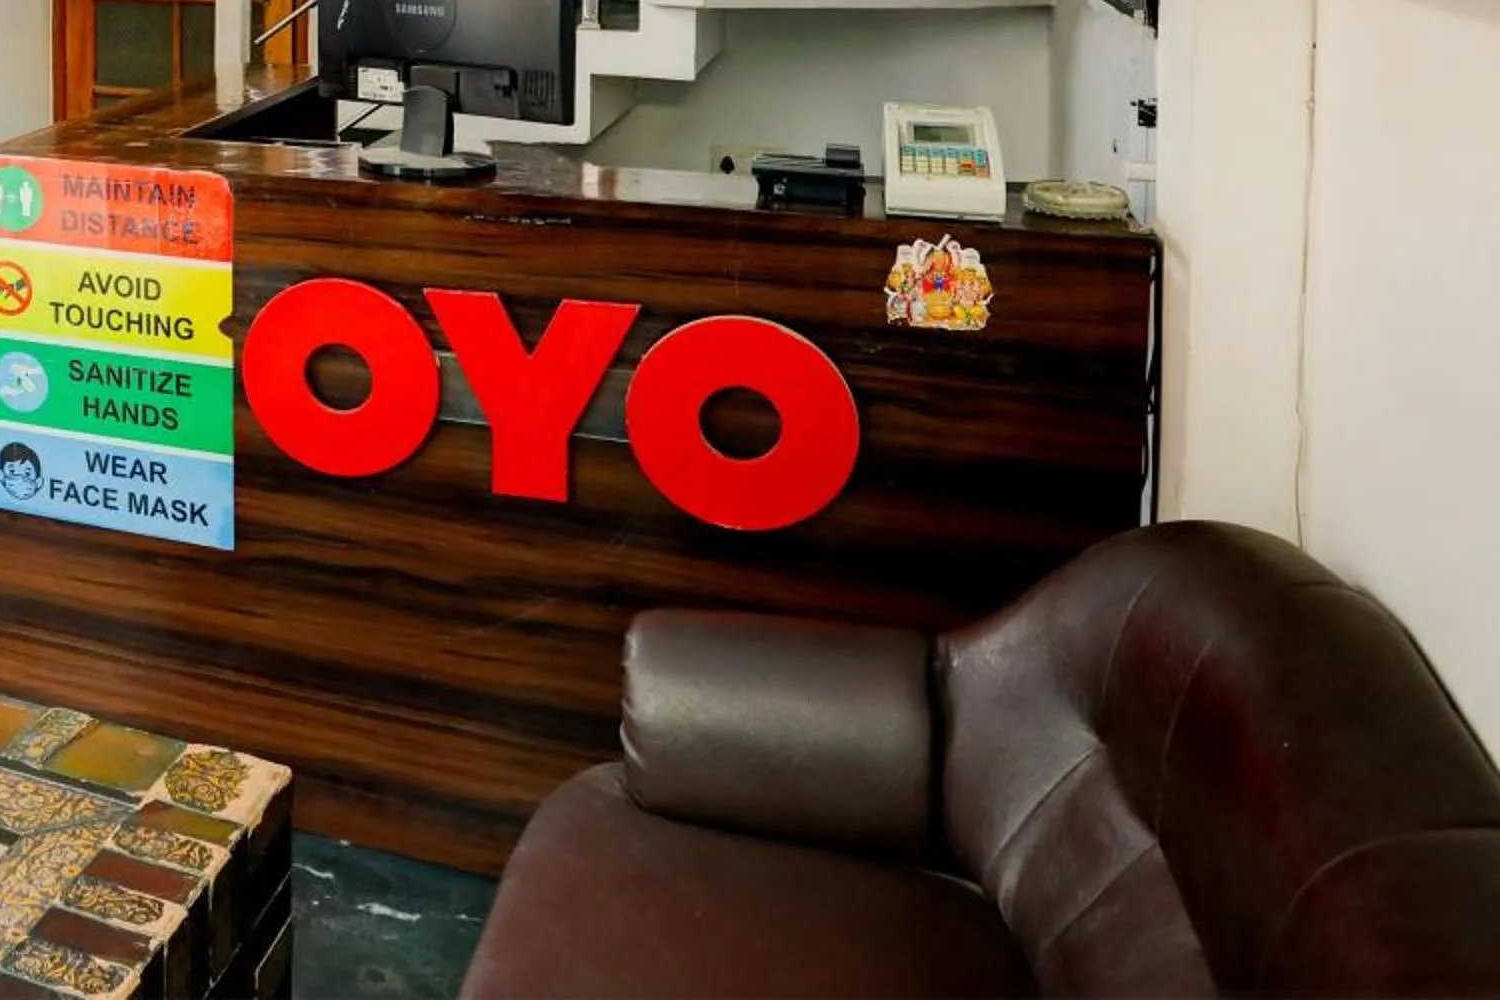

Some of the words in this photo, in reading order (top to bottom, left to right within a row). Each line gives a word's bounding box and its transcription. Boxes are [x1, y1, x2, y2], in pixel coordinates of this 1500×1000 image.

[395, 2, 445, 17] SAMSUNG
[62, 175, 196, 209] MAINTAIN
[60, 209, 200, 245] DISTANCE
[77, 271, 162, 301] AVOID
[50, 302, 194, 341] TOUCHING
[69, 359, 193, 398] SANITIZE
[83, 396, 180, 431] HANDS
[243, 277, 860, 531] OYO
[85, 450, 168, 485] WEAR
[49, 479, 119, 511] FACE
[127, 494, 209, 527] MASK
